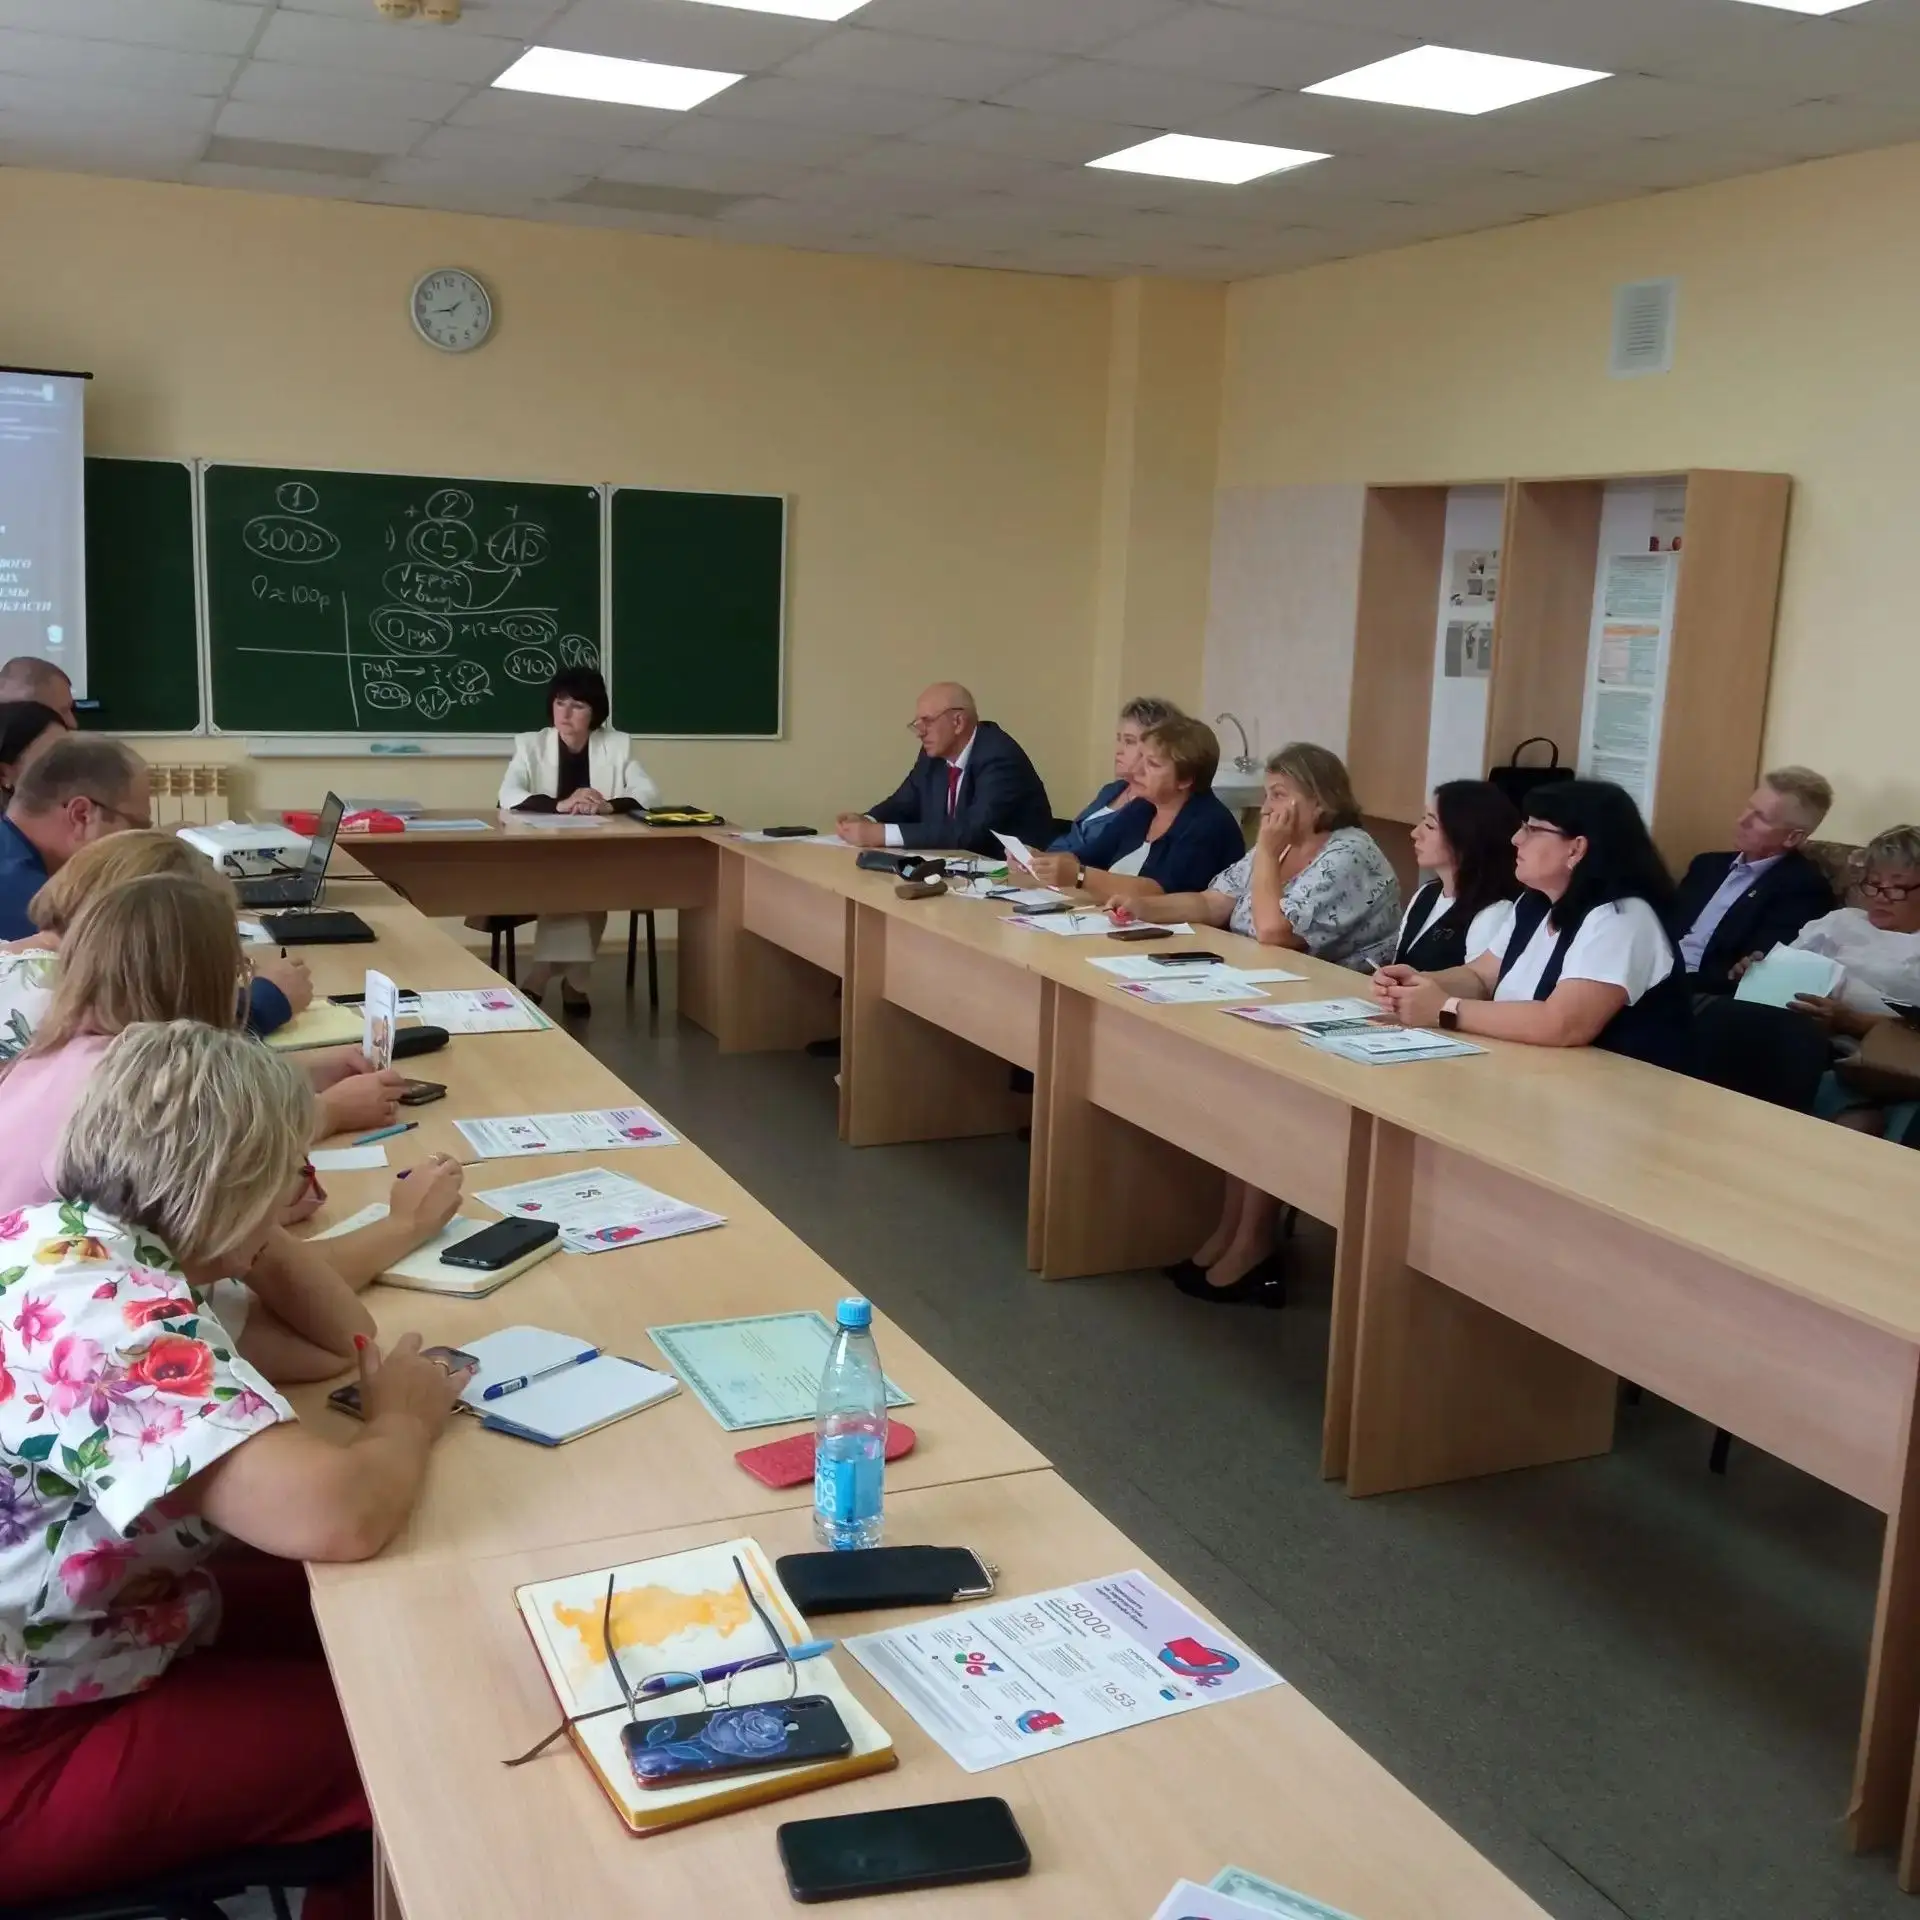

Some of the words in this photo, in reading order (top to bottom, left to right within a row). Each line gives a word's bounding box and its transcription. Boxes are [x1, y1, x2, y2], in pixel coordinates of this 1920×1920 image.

[293, 486, 301, 507] 1
[440, 493, 459, 518] 2
[253, 523, 322, 552] 3000
[1066, 1602, 1110, 1633] 5000
[1103, 1681, 1136, 1707] 1653
